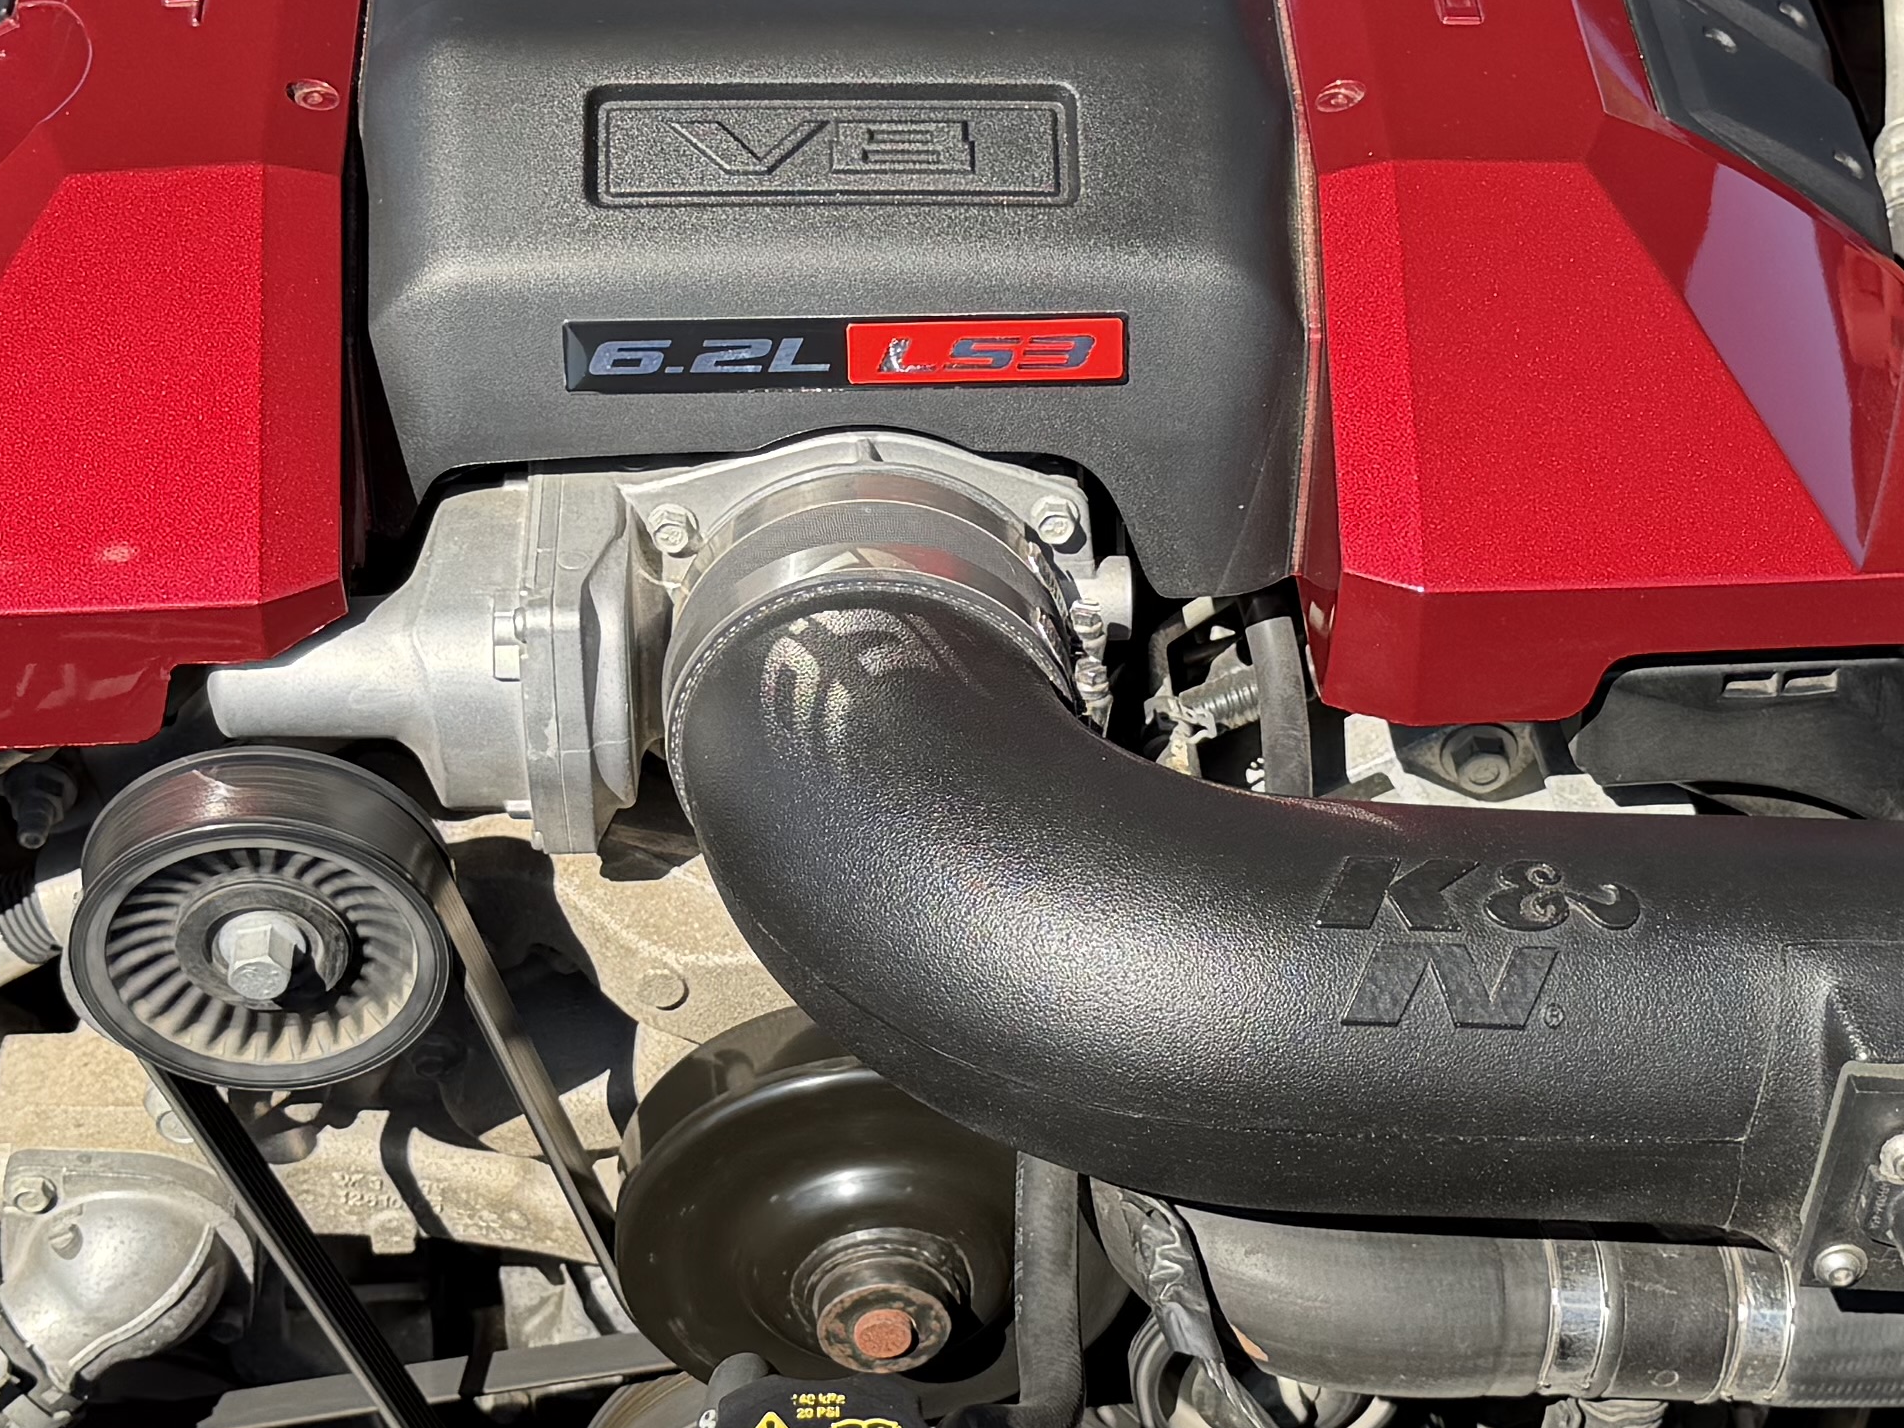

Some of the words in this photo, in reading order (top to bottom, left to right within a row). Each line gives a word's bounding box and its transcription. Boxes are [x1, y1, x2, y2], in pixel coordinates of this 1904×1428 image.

[662, 119, 976, 176] V8
[587, 335, 831, 376] 6.2L
[876, 333, 1099, 375] LS3
[796, 1407, 814, 1419] 20
[816, 1406, 841, 1419] PSI
